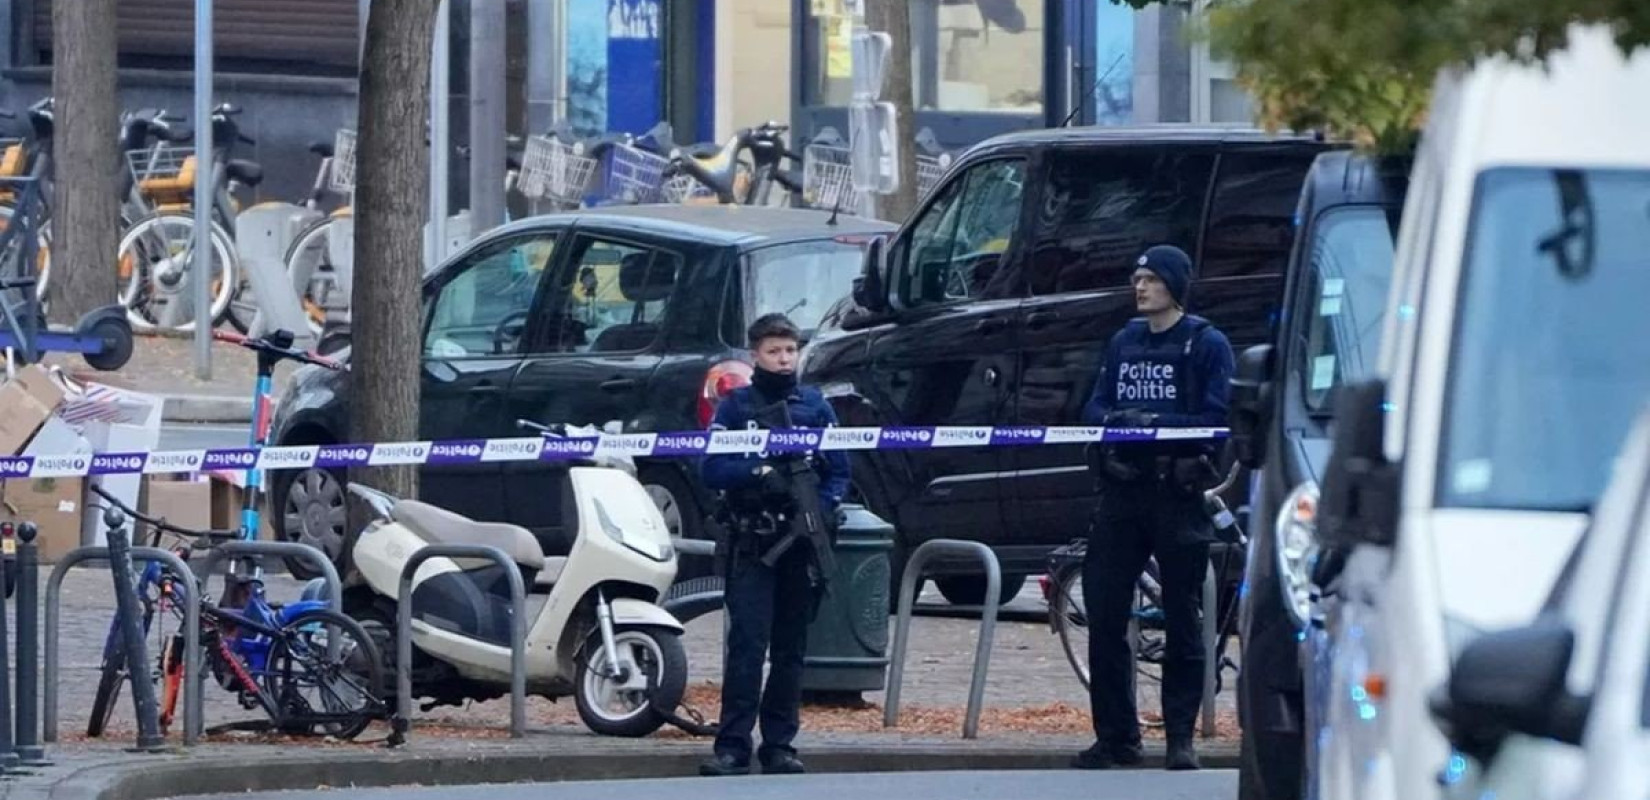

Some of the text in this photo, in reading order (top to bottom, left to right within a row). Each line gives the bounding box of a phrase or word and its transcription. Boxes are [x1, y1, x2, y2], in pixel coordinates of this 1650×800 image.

[1119, 361, 1174, 379] Police
[1117, 380, 1177, 399] Politie
[657, 436, 693, 448] Police
[714, 434, 748, 446] Politie
[770, 433, 805, 445] Police
[883, 430, 918, 442] Police
[432, 444, 468, 456] Police
[489, 441, 524, 453] Politie
[545, 440, 581, 452] Police
[603, 438, 636, 450] Politie
[264, 451, 298, 462] Politie
[320, 449, 355, 460] Police
[375, 446, 411, 457] Politie
[94, 457, 129, 468] Police
[152, 455, 185, 466] Politie
[206, 452, 241, 464] Police
[38, 459, 72, 470] Politie
